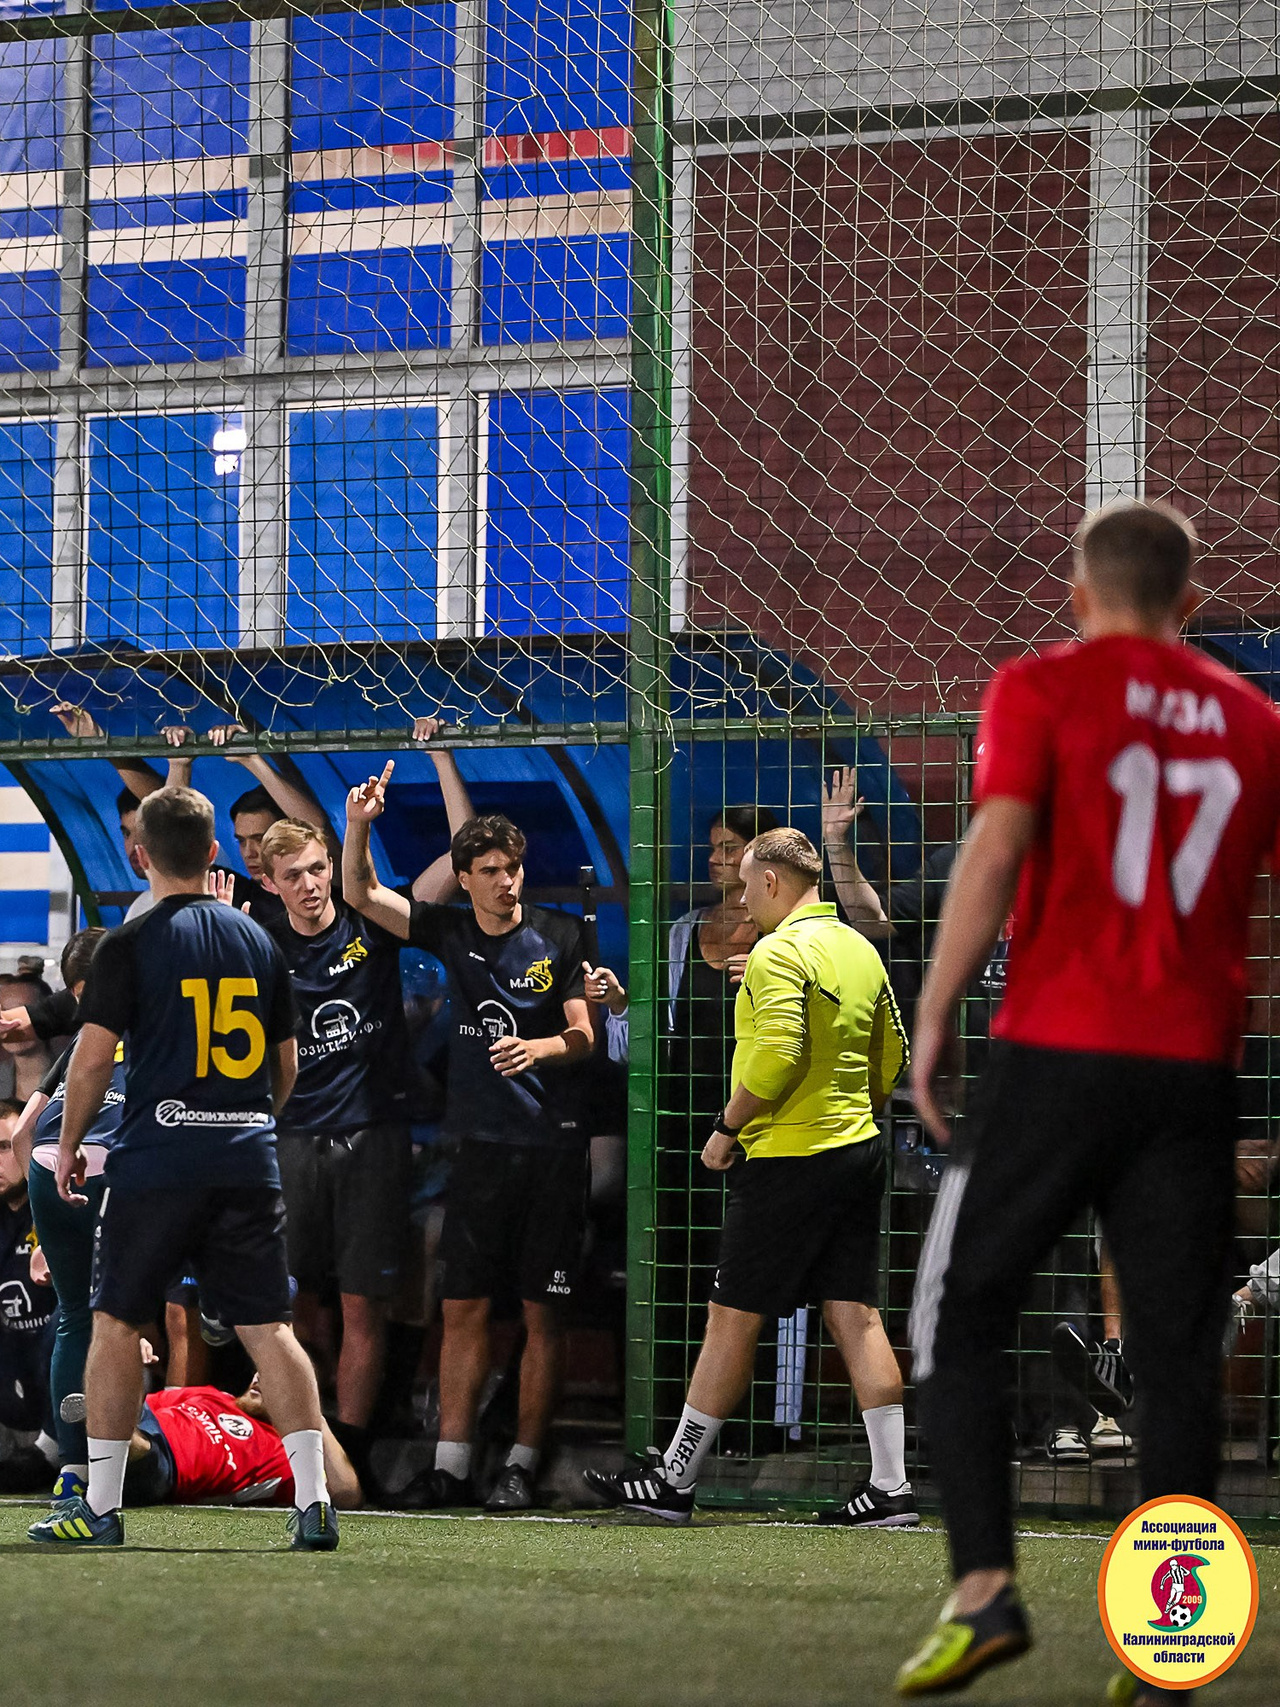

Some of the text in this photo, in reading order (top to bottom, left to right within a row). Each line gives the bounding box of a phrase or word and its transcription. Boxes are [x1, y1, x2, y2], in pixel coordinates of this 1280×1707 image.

[1106, 741, 1242, 918] 17
[180, 977, 266, 1080] 15
[546, 1283, 571, 1295] JAKO
[553, 1269, 567, 1284] 95
